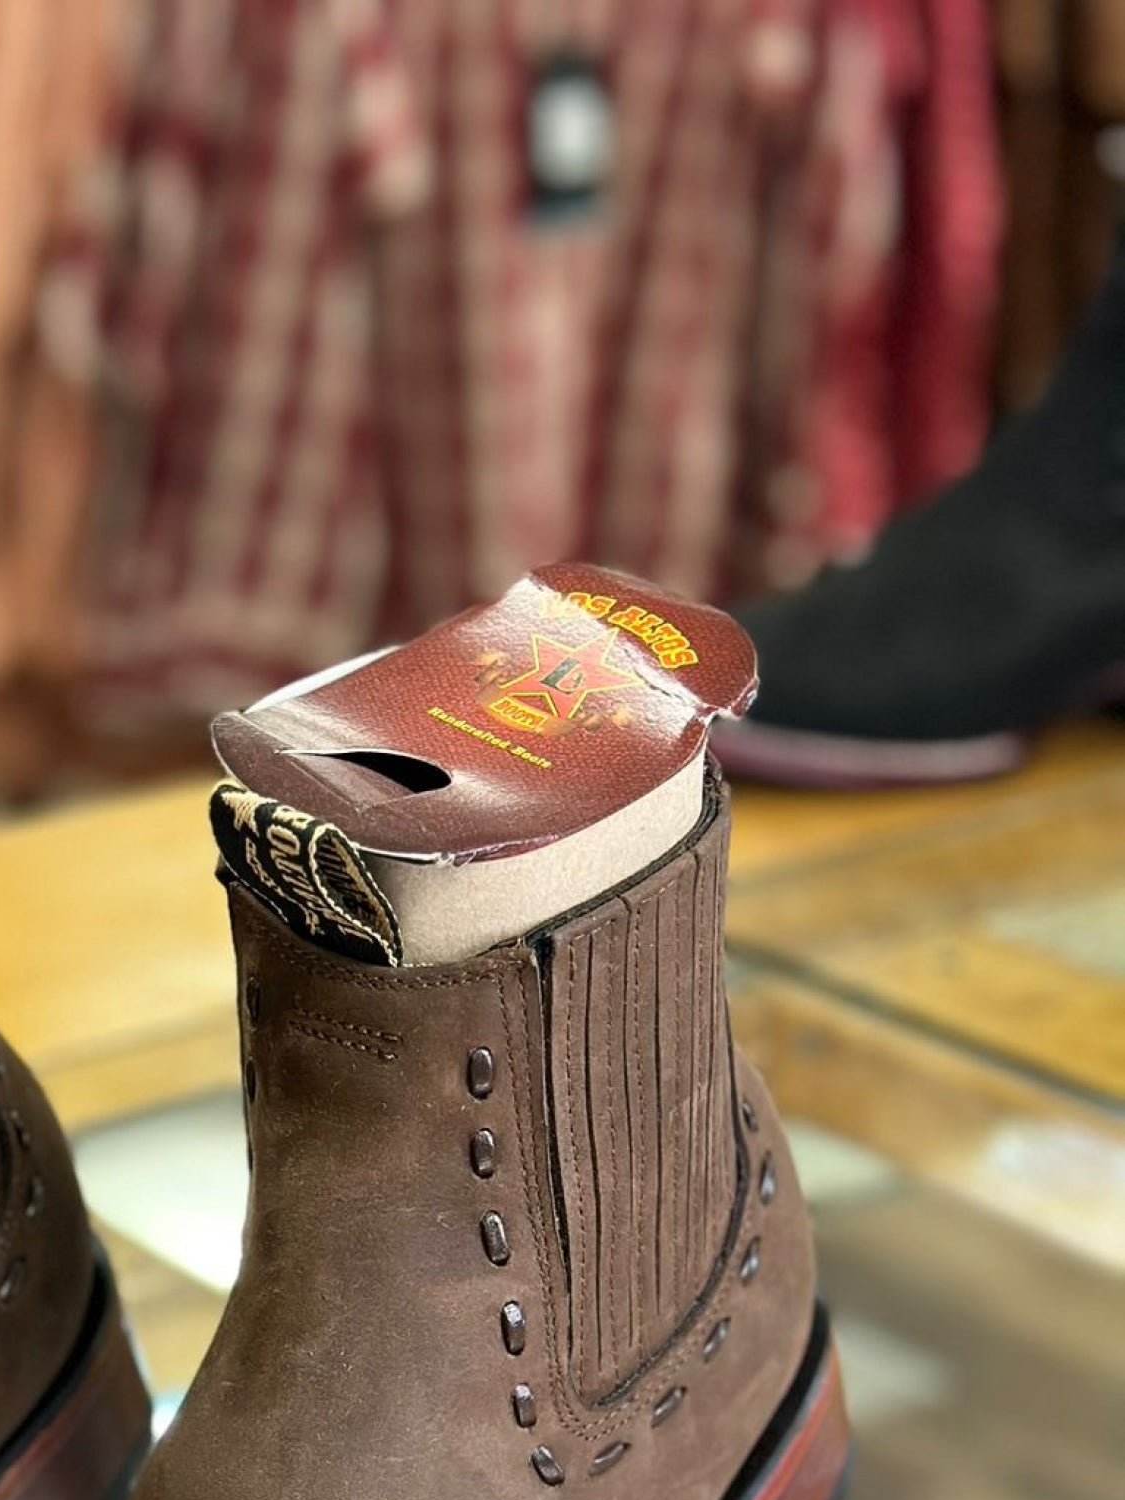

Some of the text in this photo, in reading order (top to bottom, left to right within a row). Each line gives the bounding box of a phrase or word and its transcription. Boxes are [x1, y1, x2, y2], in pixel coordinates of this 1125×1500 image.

[608, 606, 699, 668] ALTOS
[428, 706, 553, 769] Handcrafted Boots
